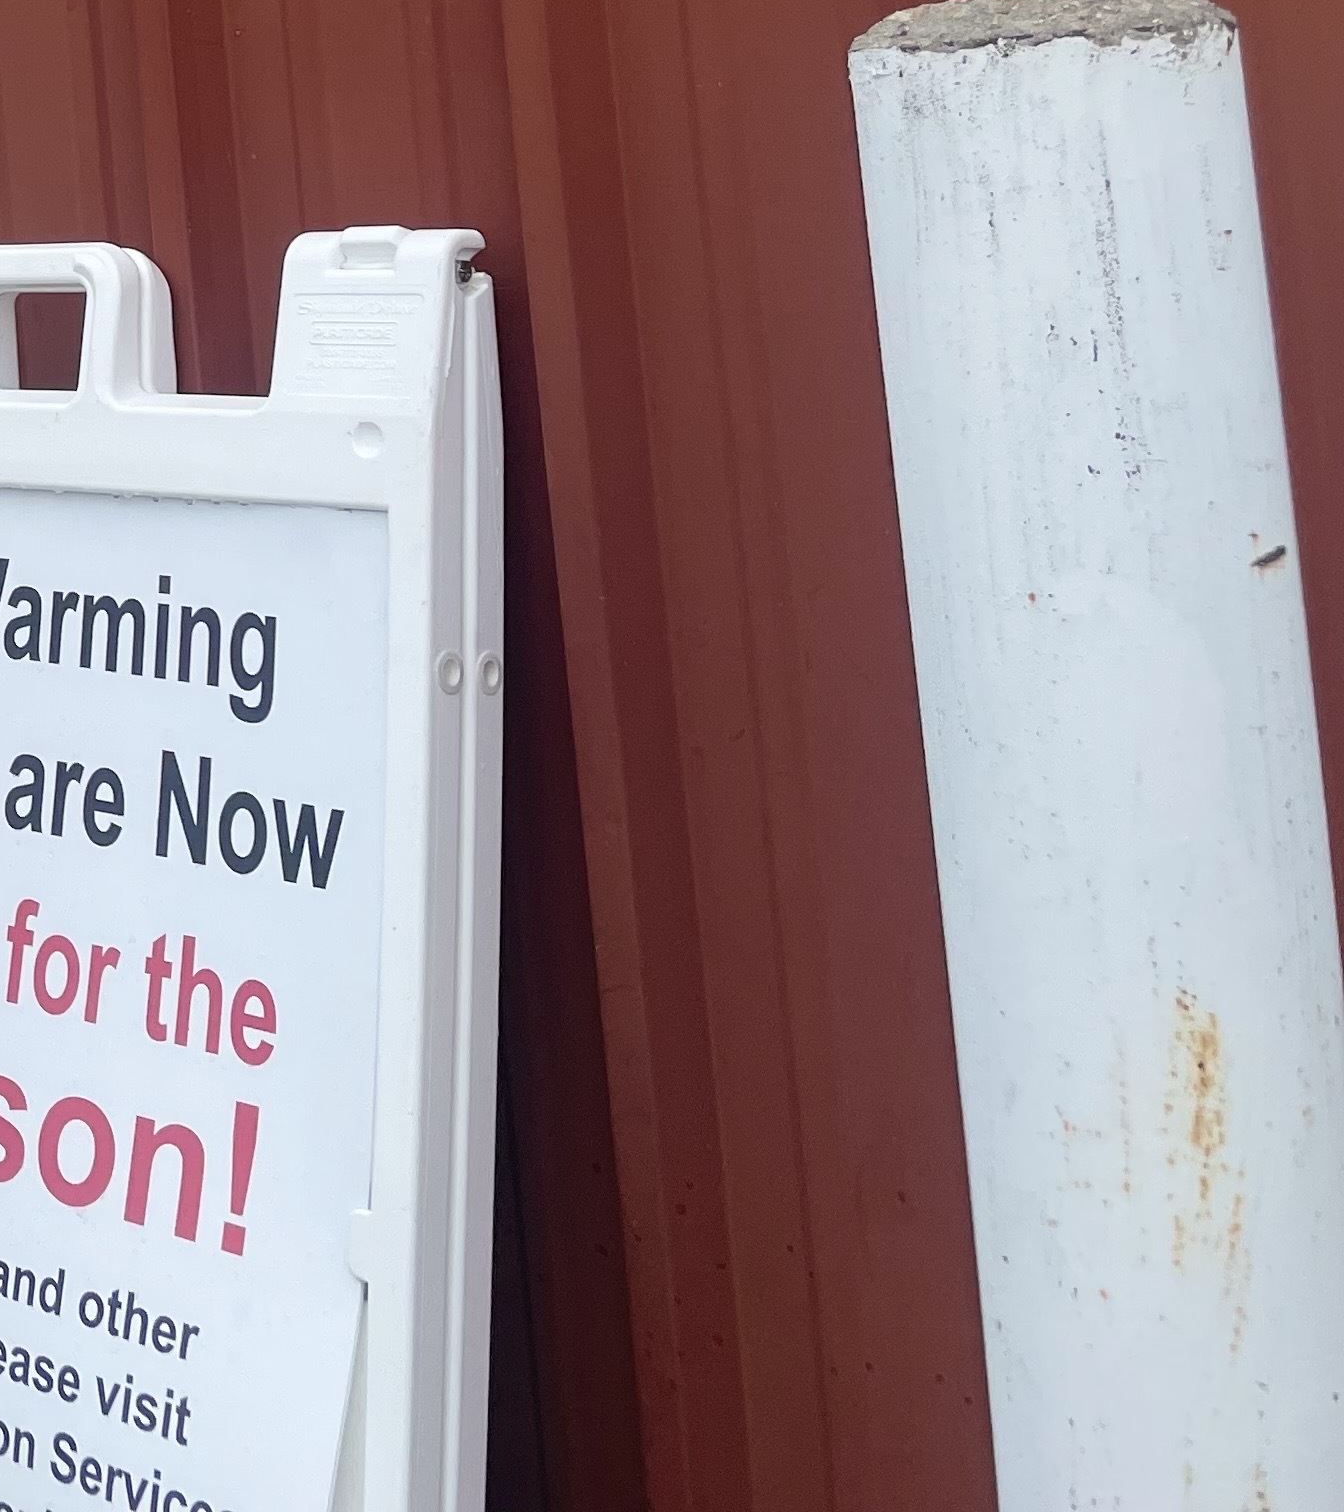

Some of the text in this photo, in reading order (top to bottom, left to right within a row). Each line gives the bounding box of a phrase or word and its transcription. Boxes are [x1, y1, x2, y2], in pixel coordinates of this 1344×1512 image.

[4, 753, 125, 847] are
[155, 749, 345, 890] Now
[6, 899, 121, 1024] for
[144, 933, 278, 1066] the
[78, 1289, 200, 1360] other
[96, 1373, 191, 1447] visit
